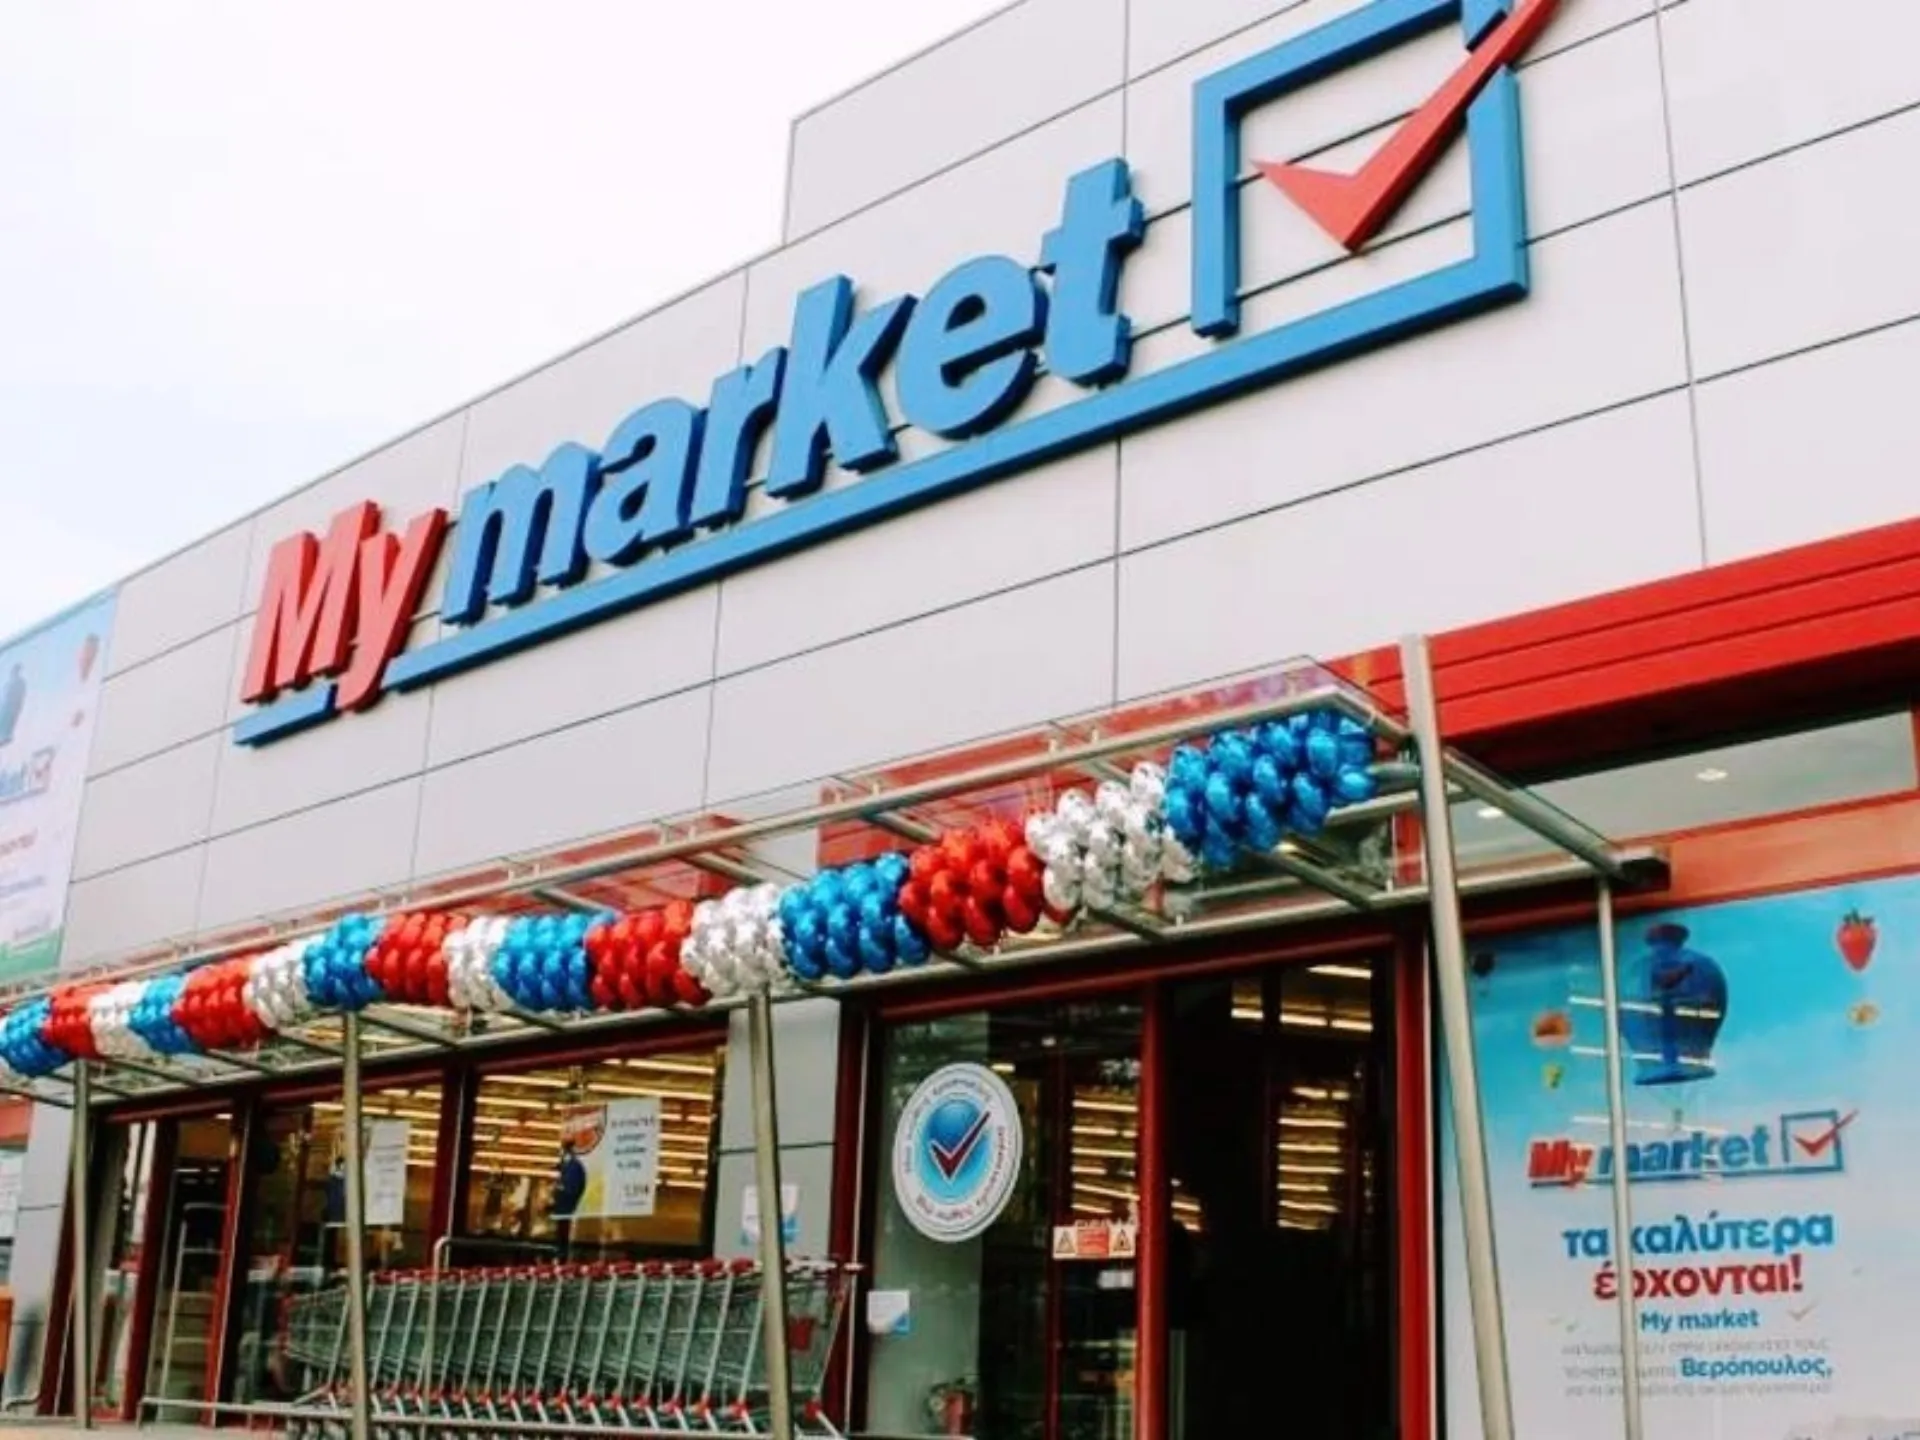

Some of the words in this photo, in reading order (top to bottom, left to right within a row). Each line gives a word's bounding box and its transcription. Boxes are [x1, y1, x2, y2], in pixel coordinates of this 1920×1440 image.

[239, 498, 449, 715] My
[441, 157, 1146, 626] market
[1528, 1139, 1594, 1188] My
[1599, 1124, 1769, 1175] market
[1562, 1225, 1610, 1257] τα
[1640, 1310, 1672, 1333] My
[1679, 1308, 1760, 1330] market
